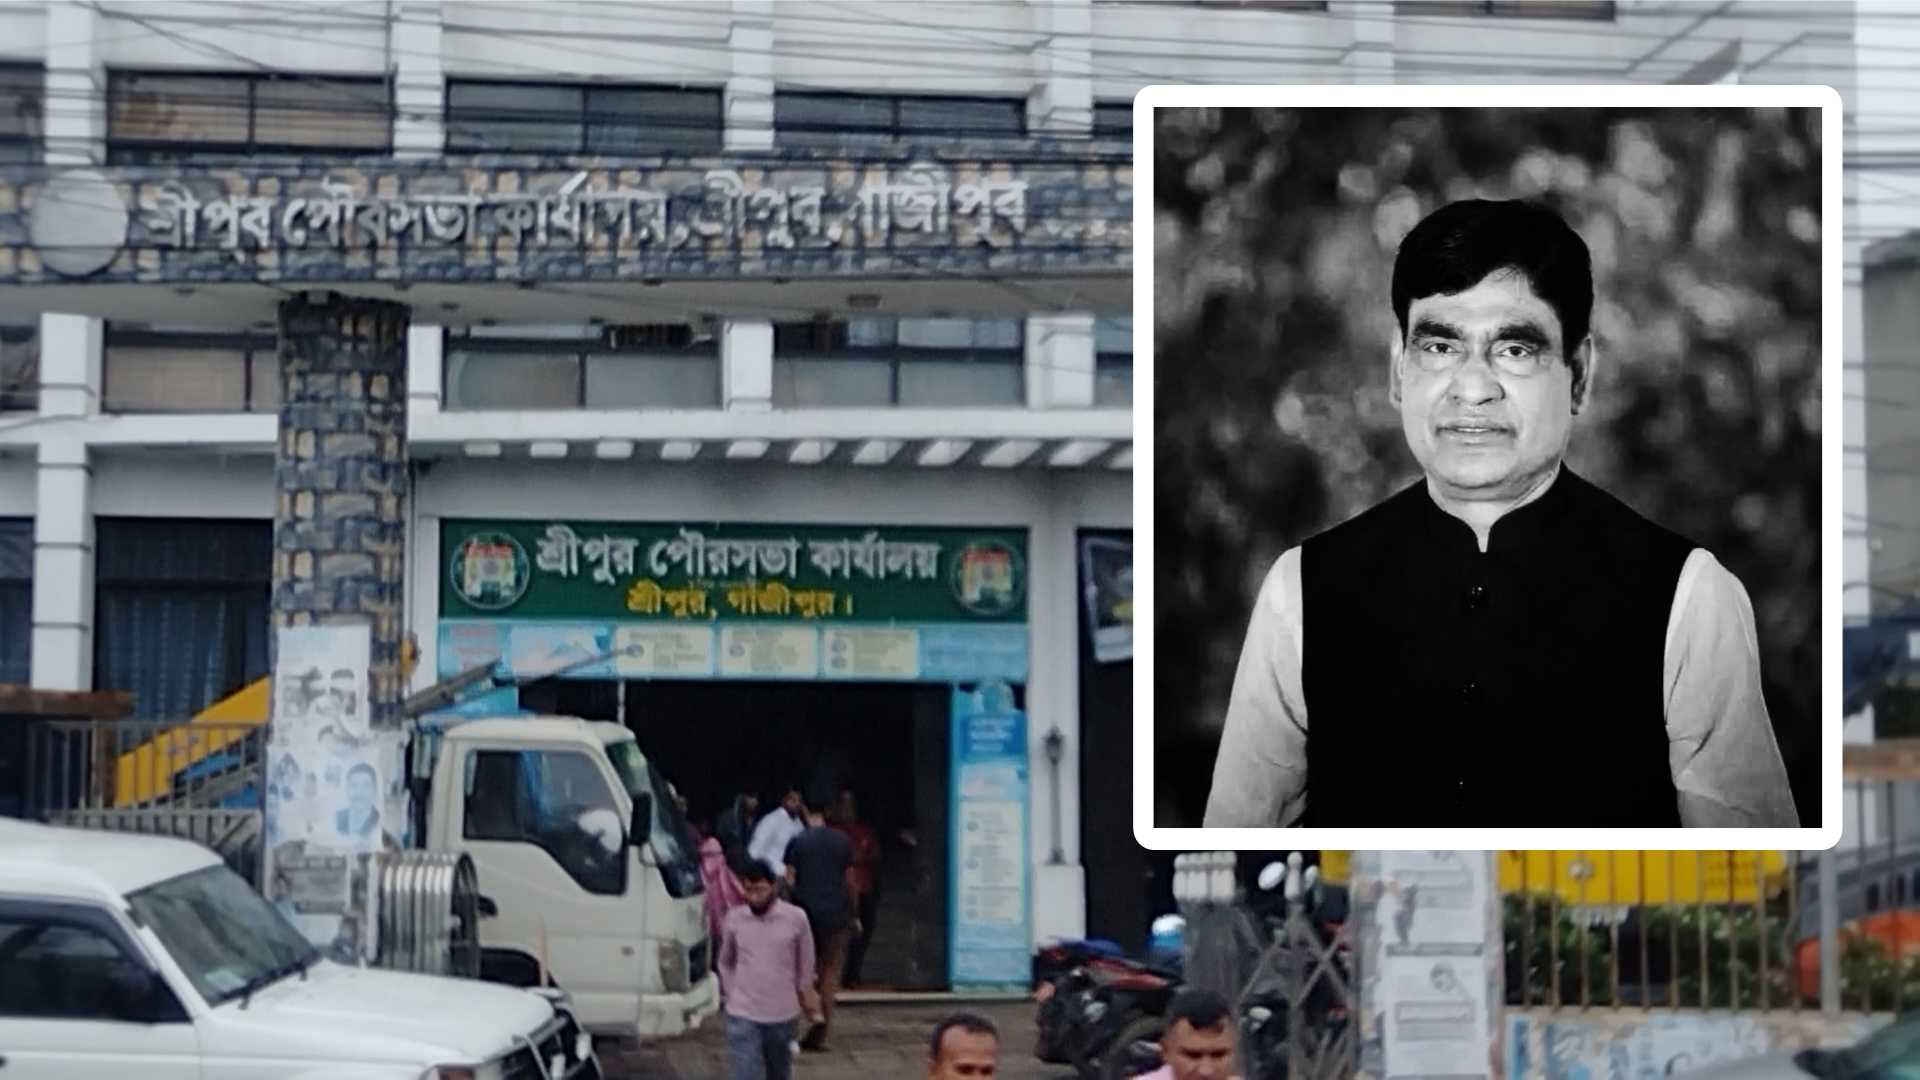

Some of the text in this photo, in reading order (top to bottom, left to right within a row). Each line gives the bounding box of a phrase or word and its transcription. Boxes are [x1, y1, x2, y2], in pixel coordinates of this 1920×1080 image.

[536, 524, 942, 586] শ্রীপুর পৌরসভা কার্যালয়
